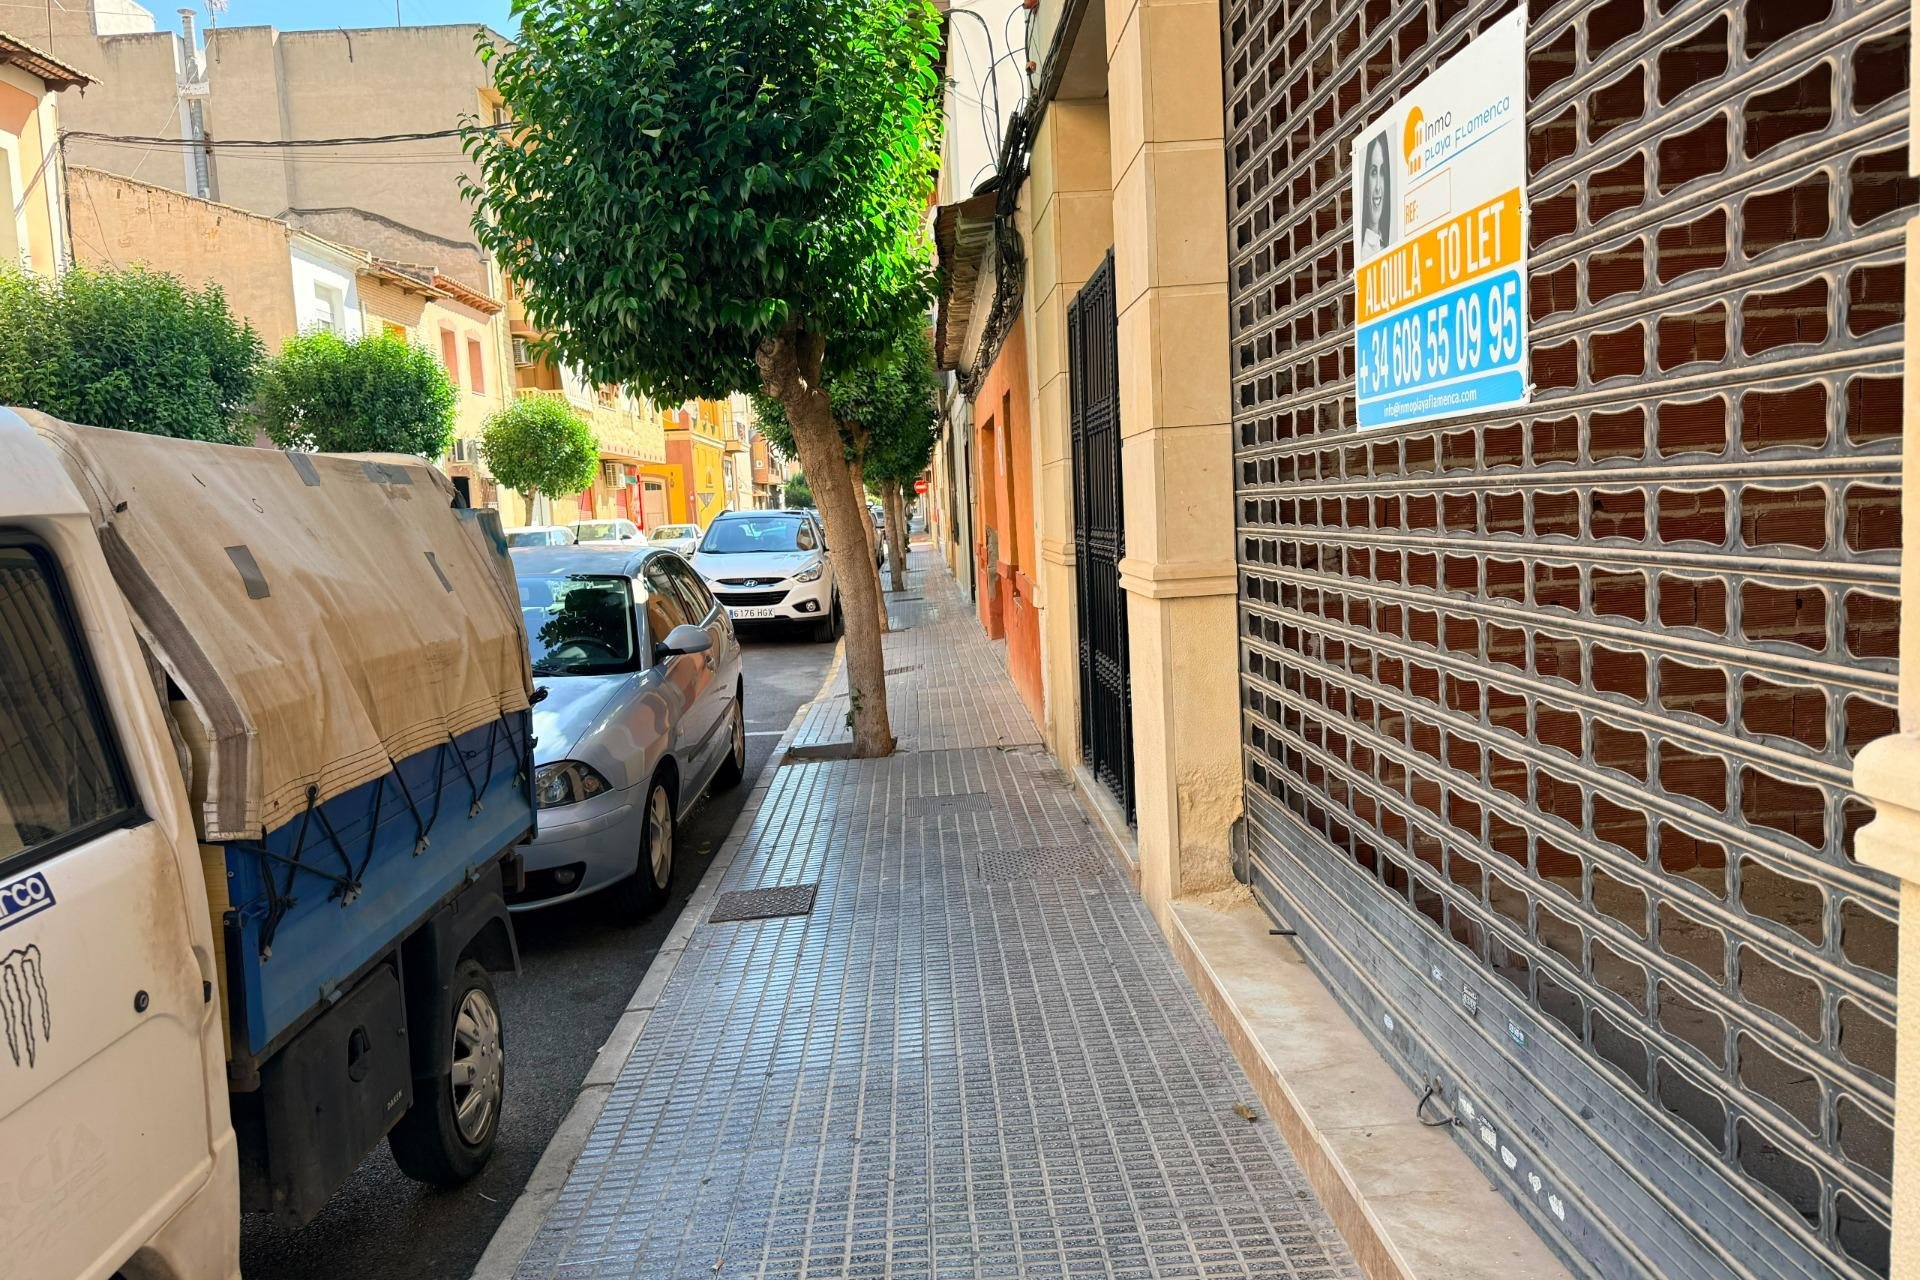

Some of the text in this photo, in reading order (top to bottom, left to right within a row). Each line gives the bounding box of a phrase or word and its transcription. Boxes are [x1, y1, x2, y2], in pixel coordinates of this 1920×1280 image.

[1404, 200, 1419, 225] REF:
[1365, 241, 1422, 317] ALQUILA
[1437, 222, 1461, 284] TO
[1466, 199, 1505, 274] LET
[1392, 314, 1421, 387] 608
[1426, 303, 1450, 378] 55
[1455, 292, 1482, 371] 09
[1487, 279, 1517, 364] 95
[1383, 388, 1477, 418] info@inmoplayaflamenca.com
[734, 609, 755, 618] 6176
